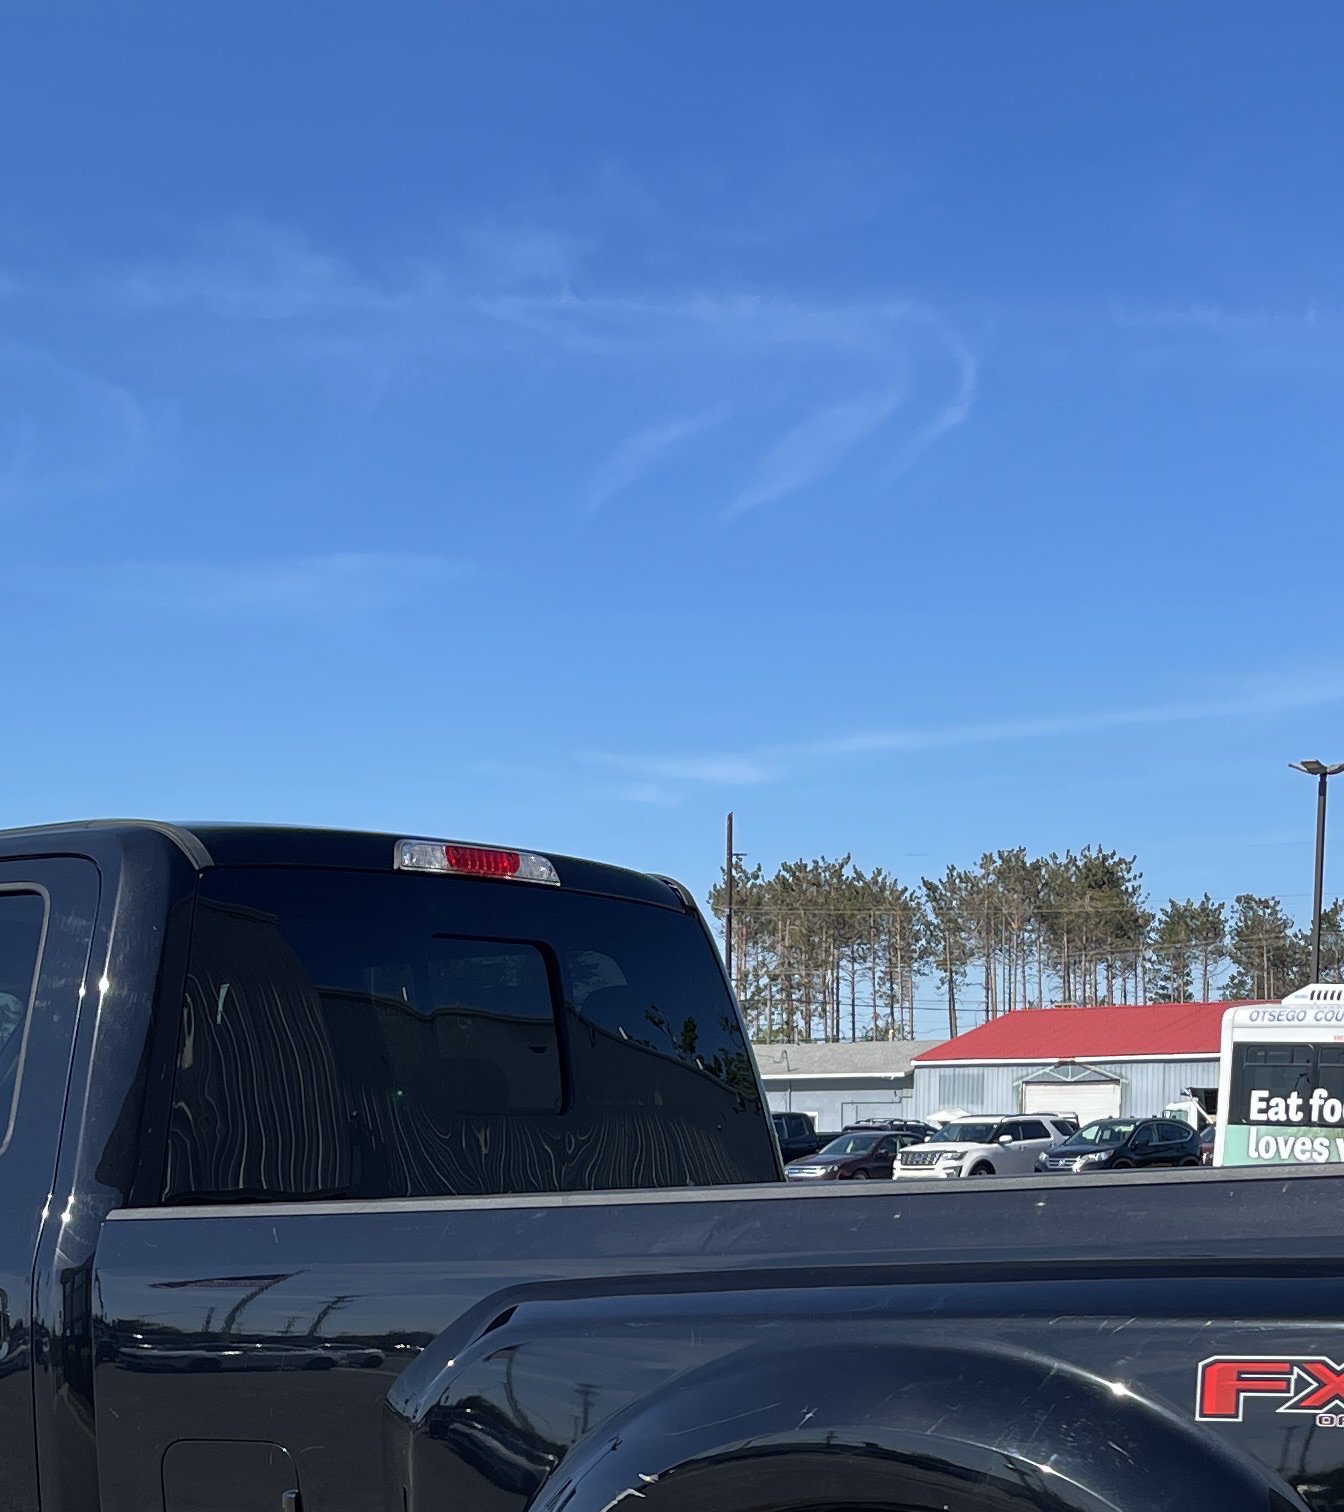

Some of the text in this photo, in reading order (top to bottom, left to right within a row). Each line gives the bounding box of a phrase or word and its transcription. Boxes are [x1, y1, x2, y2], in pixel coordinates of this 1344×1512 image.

[1249, 1010, 1307, 1023] OTSEGO
[1249, 1089, 1304, 1122] Eat
[1247, 1126, 1332, 1163] loves
